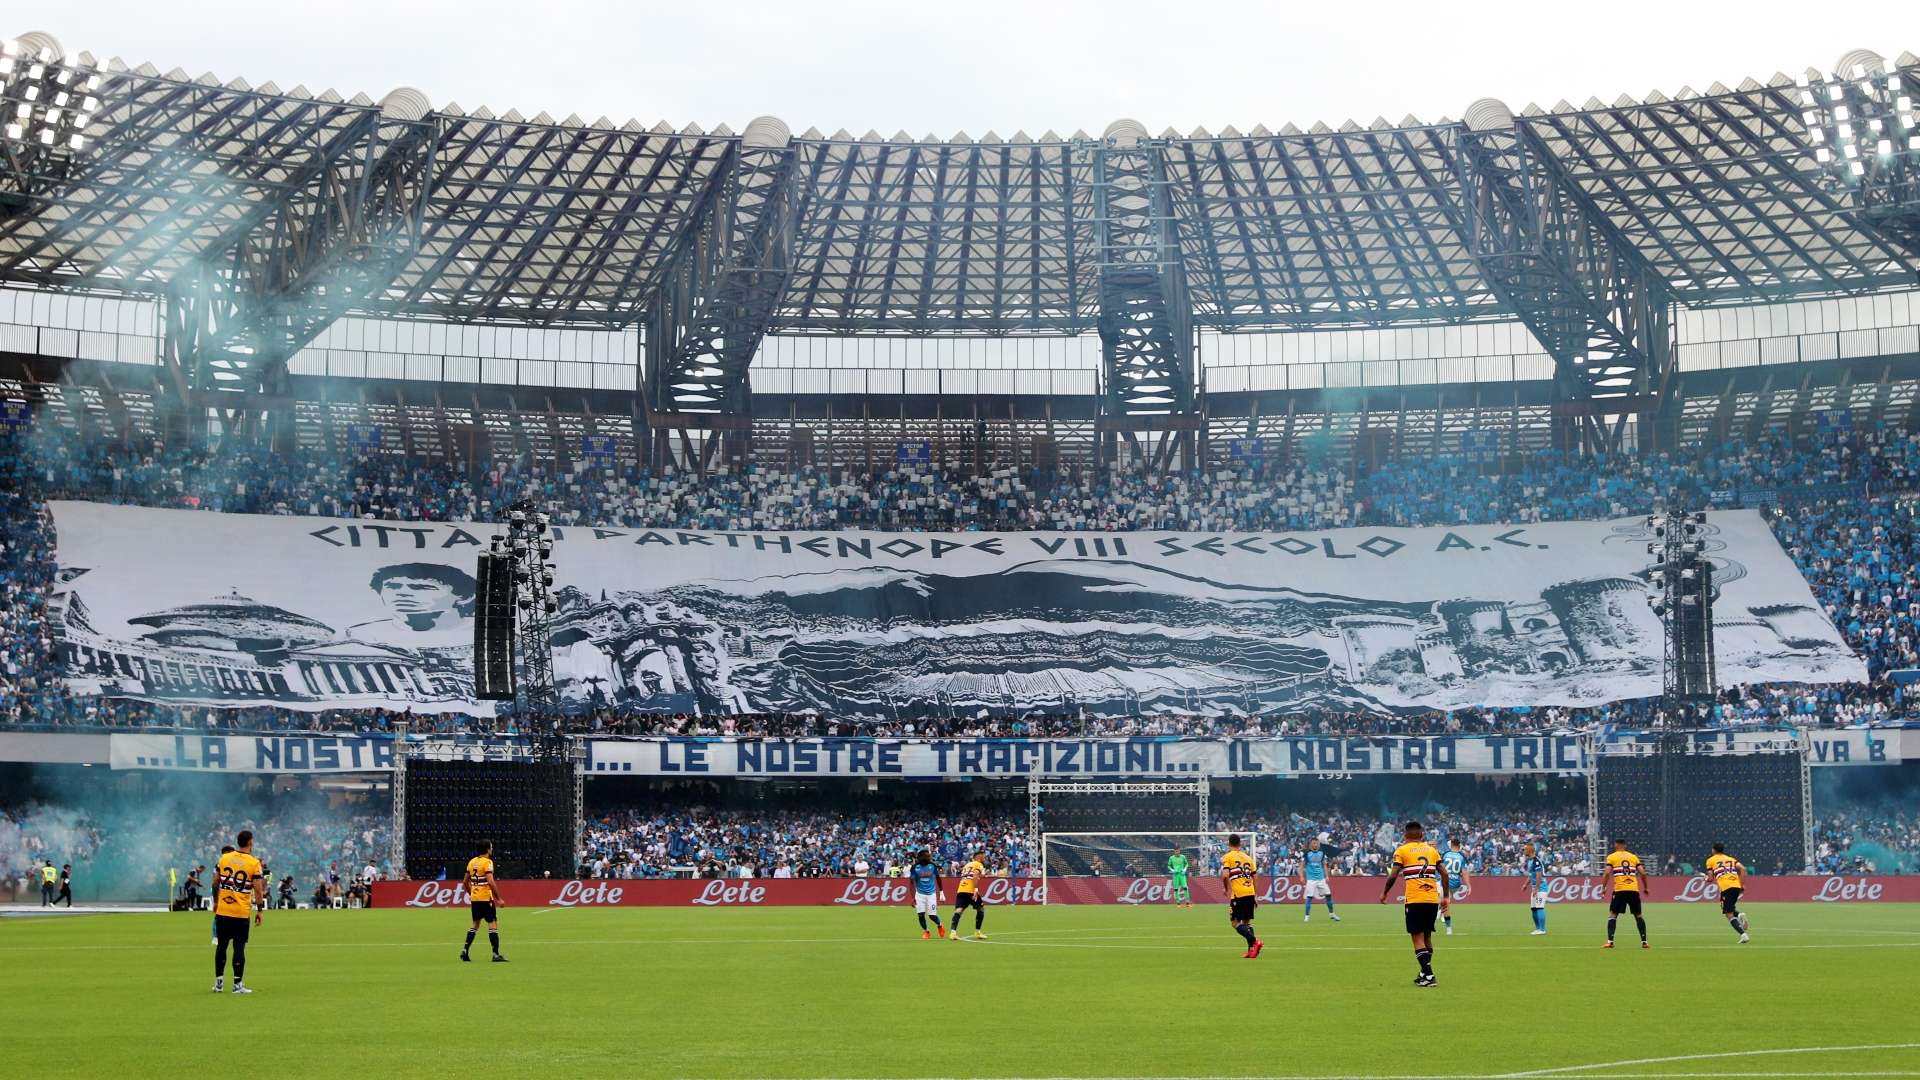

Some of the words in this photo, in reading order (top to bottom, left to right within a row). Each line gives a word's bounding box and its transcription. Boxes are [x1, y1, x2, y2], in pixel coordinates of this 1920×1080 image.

[308, 524, 483, 548] CITTÀ
[592, 527, 1007, 559] PARTHENOPE
[1029, 537, 1129, 558] VIII
[1154, 535, 1407, 560] SECOLO
[1434, 528, 1549, 552] A.C.
[659, 740, 709, 772] LE
[737, 742, 903, 773] NOSTRE
[1229, 739, 1262, 771] IL
[1289, 738, 1456, 770] NOSTRO
[1417, 856, 1430, 878] 2
[1444, 858, 1461, 874] 20
[1621, 859, 1631, 876] 8
[550, 880, 624, 906] Lete
[692, 879, 766, 905] Lete
[834, 878, 908, 905] Lete
[982, 878, 1049, 905] Lete
[1811, 876, 1884, 902] Lete
